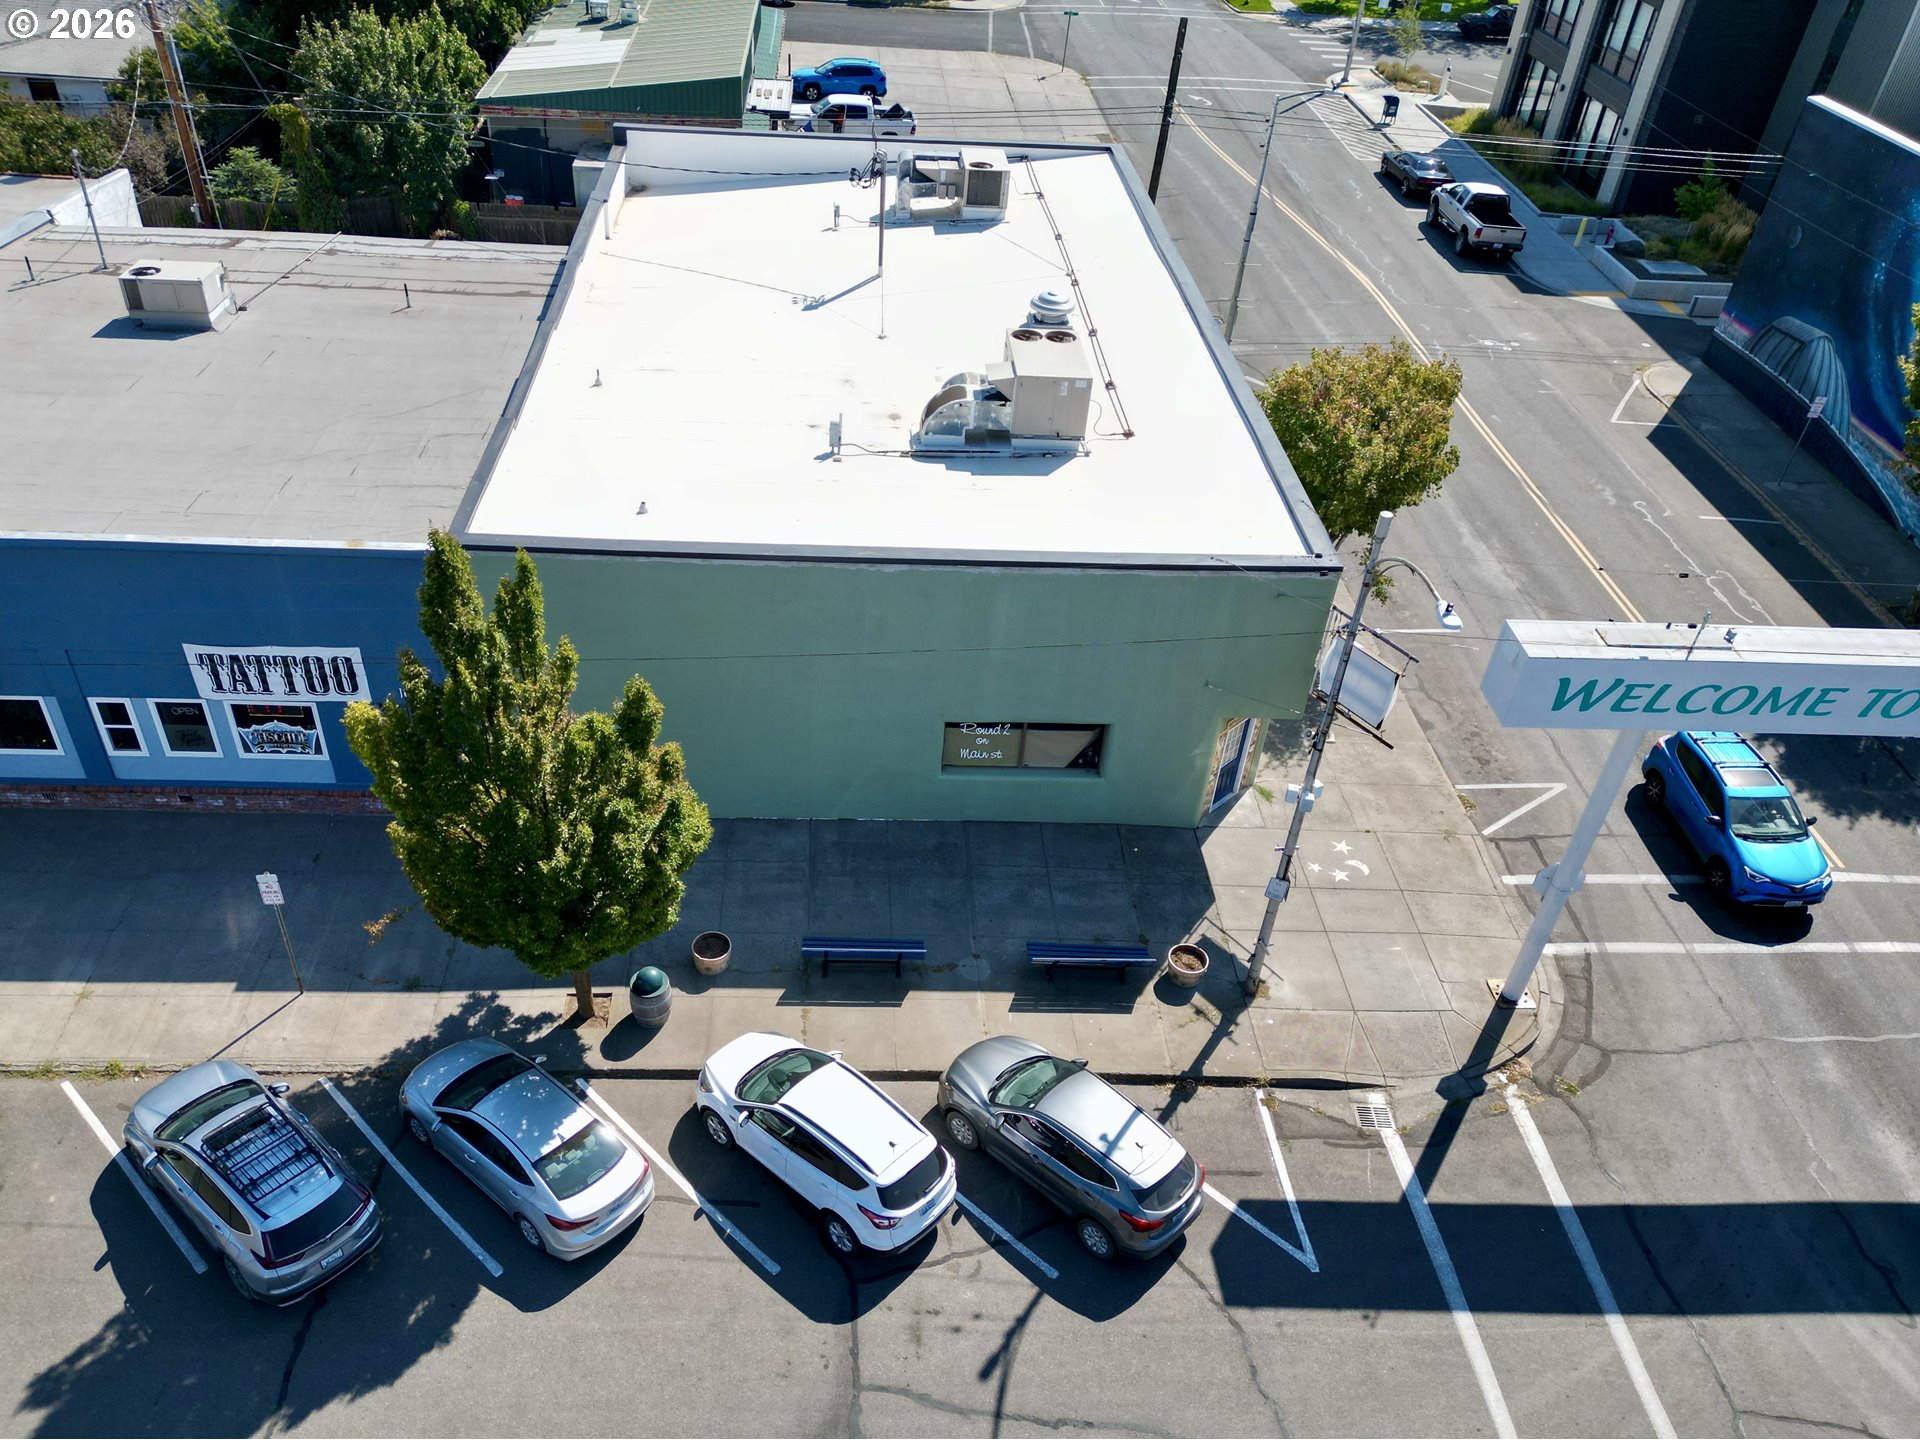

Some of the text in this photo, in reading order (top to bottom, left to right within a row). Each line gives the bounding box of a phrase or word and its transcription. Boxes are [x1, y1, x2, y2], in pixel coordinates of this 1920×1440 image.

[195, 653, 360, 696] TATTOO
[1551, 677, 1920, 719] WELCOME TO
[171, 706, 199, 716] OPEN
[960, 722, 1011, 735] Round 2
[975, 737, 990, 745] on
[960, 748, 989, 759] Main
